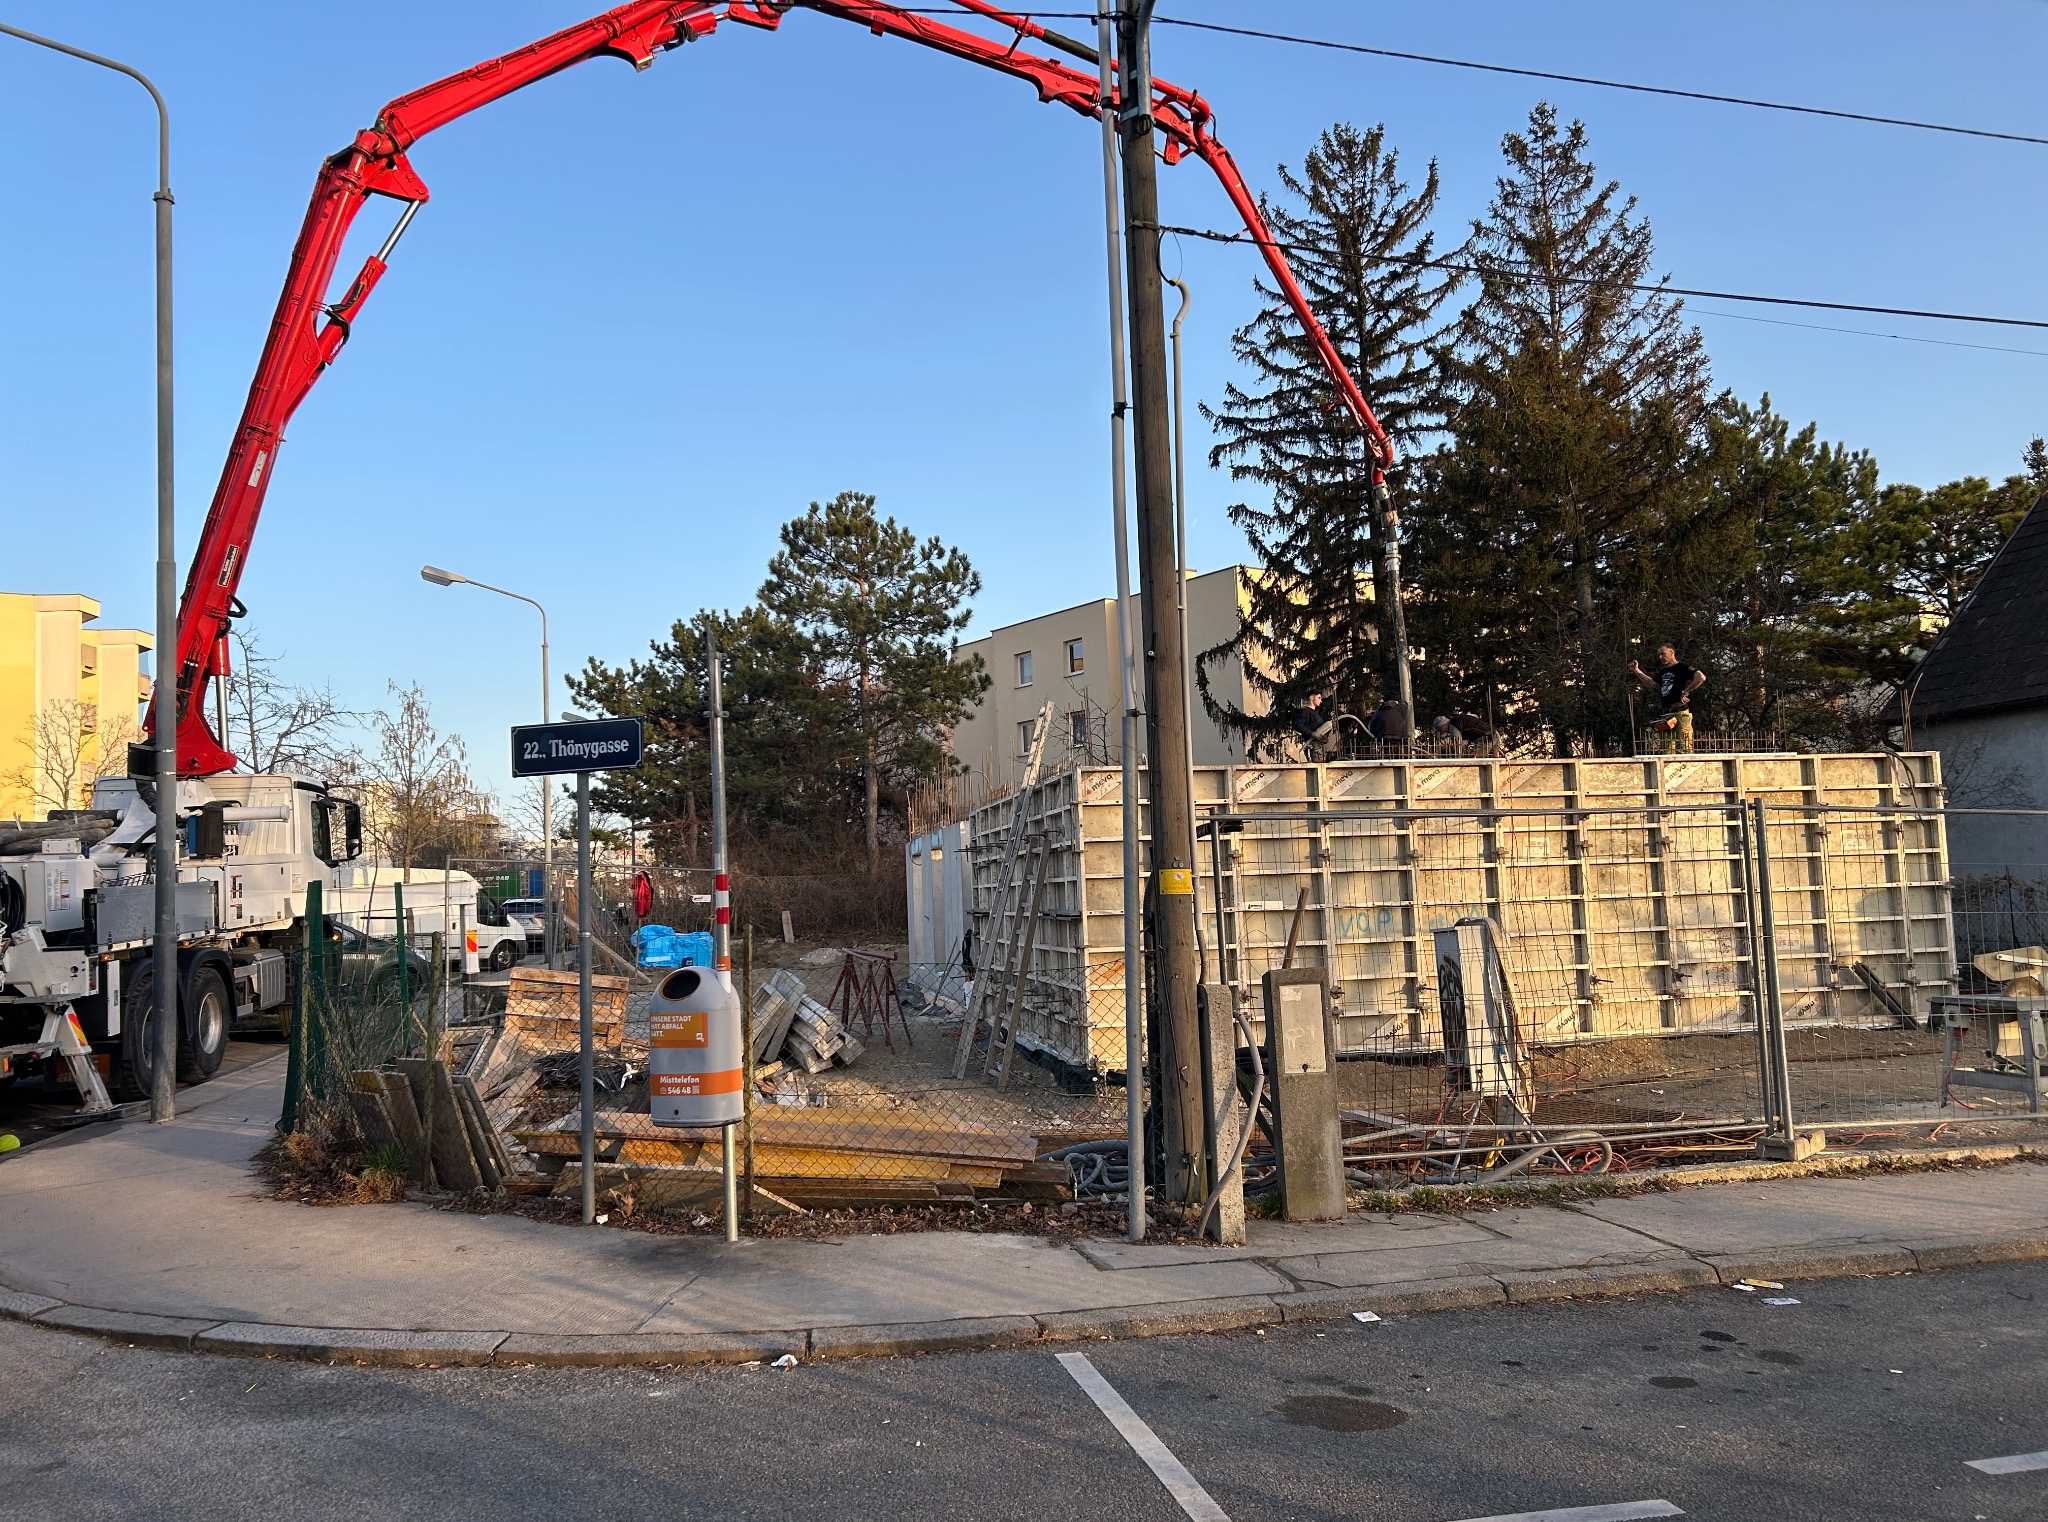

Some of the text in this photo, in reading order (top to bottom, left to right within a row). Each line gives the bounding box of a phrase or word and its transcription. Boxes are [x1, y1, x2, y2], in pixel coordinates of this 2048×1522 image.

[549, 738, 630, 759] Thönygasse
[1091, 773, 1113, 791] meva
[1244, 770, 1266, 789] meva
[1420, 768, 1441, 786] meva
[660, 1076, 700, 1084] Misttelefon
[667, 1086, 692, 1095] 546 48
